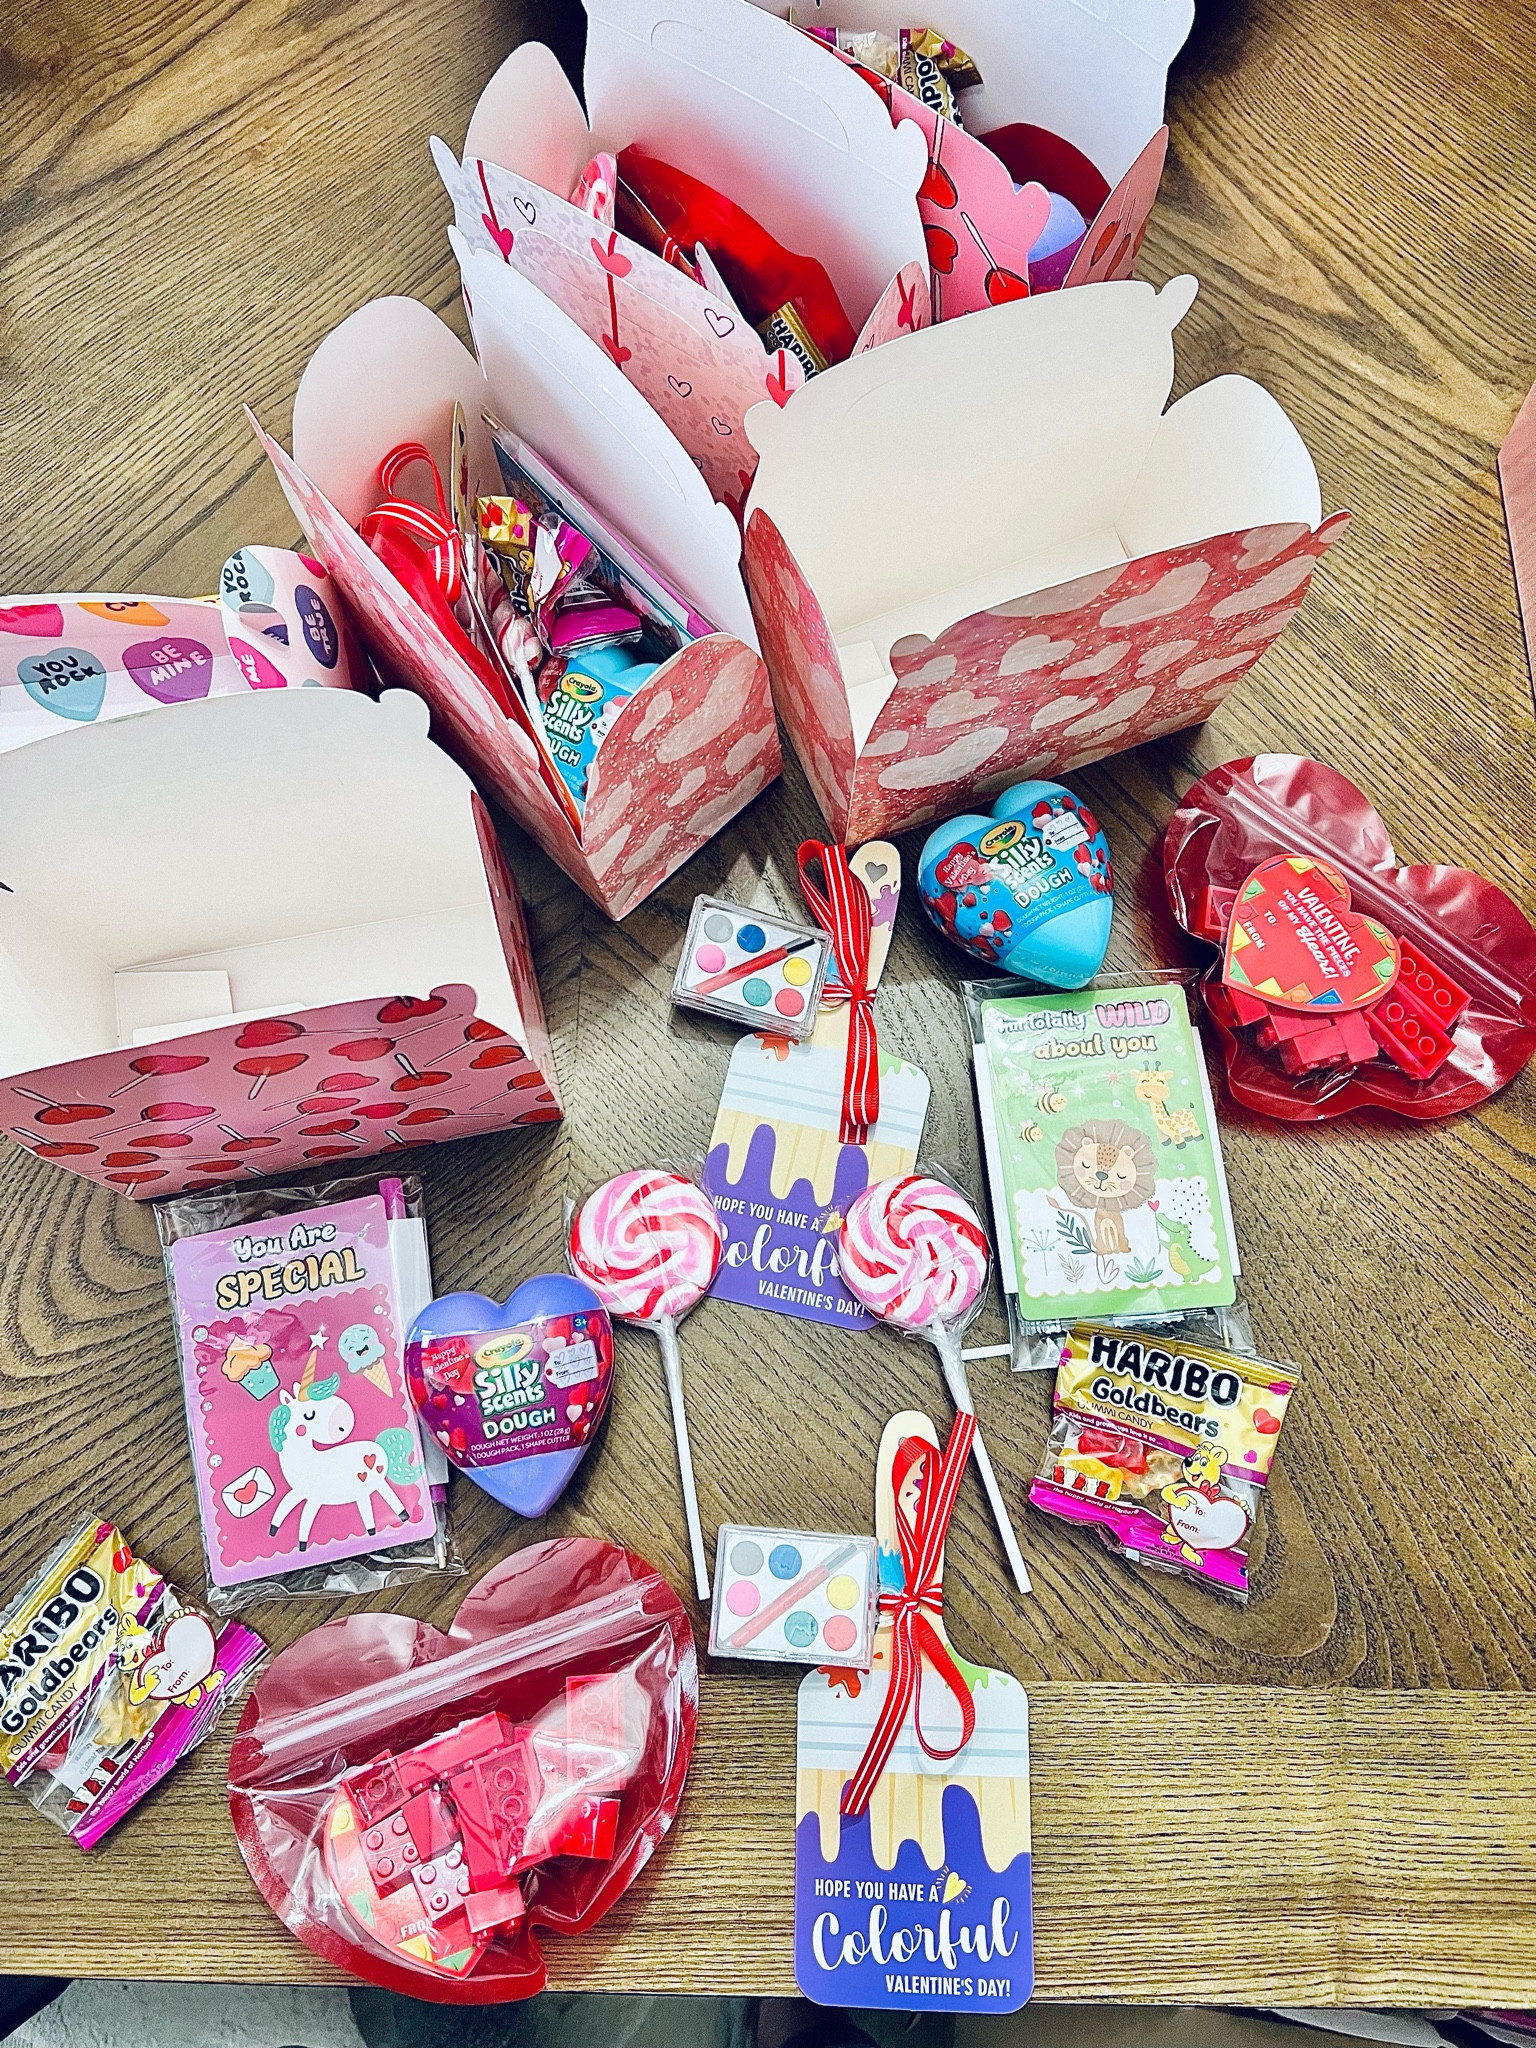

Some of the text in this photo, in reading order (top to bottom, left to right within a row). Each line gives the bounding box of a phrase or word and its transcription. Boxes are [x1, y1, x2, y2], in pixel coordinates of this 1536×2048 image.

[223, 568, 238, 593] YO
[304, 613, 321, 642] BE
[310, 598, 332, 655] TRUE
[32, 655, 79, 676] YOU
[150, 643, 182, 663] BE
[39, 666, 101, 695] ROCK
[150, 650, 207, 687] MINE
[568, 677, 598, 693] Crayola
[547, 690, 594, 726] Silly
[551, 739, 581, 767] UGH
[985, 825, 1016, 848] Crayola
[942, 851, 964, 874] Happy
[944, 850, 977, 886] Valentine's
[988, 837, 1042, 876] Silly
[1006, 852, 1054, 890] scents
[961, 866, 977, 882] Day
[1013, 867, 1073, 909] DOUGH
[1263, 909, 1278, 928] TO:
[1297, 886, 1361, 966] VALENTINE,
[1242, 921, 1267, 952] FROM:
[1277, 899, 1340, 979] OF MY Heart!
[1282, 889, 1351, 978] YOU HAVE THE PIECES
[1025, 1009, 1086, 1032] totally
[1095, 1000, 1170, 1029] WILD
[1033, 1033, 1158, 1060] about you
[714, 1195, 820, 1232] HOPE YOU HAVE A
[232, 1221, 337, 1263] You Are
[720, 1223, 842, 1287] olorf
[216, 1246, 367, 1312] SPECIAL
[758, 1280, 866, 1319] VALENTINE'S DAY!
[574, 1318, 588, 1327] 3+
[431, 1345, 457, 1362] Happy
[484, 1338, 525, 1357] Crayola
[442, 1367, 461, 1381] Day
[474, 1360, 541, 1400] Silly
[1090, 1334, 1241, 1407] HARIBO
[481, 1384, 545, 1416] scents
[1091, 1377, 1221, 1439] Goldbears
[482, 1407, 556, 1439] DOUGH
[1118, 1411, 1154, 1430] CANDY
[470, 1441, 496, 1452] DOUGH
[496, 1438, 510, 1447] NET
[510, 1431, 540, 1443] WEIGHT:
[543, 1429, 553, 1437] OZ
[476, 1449, 501, 1459] DOUGH
[525, 1439, 546, 1449] SHAPE
[547, 1435, 570, 1445] CUTTER
[1194, 1506, 1206, 1517] To:
[1177, 1519, 1201, 1534] From:
[0, 1569, 101, 1709] ARIBO
[1, 1607, 118, 1733] Goldbears
[160, 1658, 175, 1673] To:
[168, 1668, 191, 1694] From:
[10, 1682, 78, 1756] GUMMI CANDY
[26, 1747, 40, 1762] and
[98, 1785, 117, 1806] happy
[815, 1878, 939, 1903] HOPE YOU HAVE A
[812, 1896, 1019, 1971] Colorful
[885, 1974, 1011, 1998] VALENTINE'S DAY!
